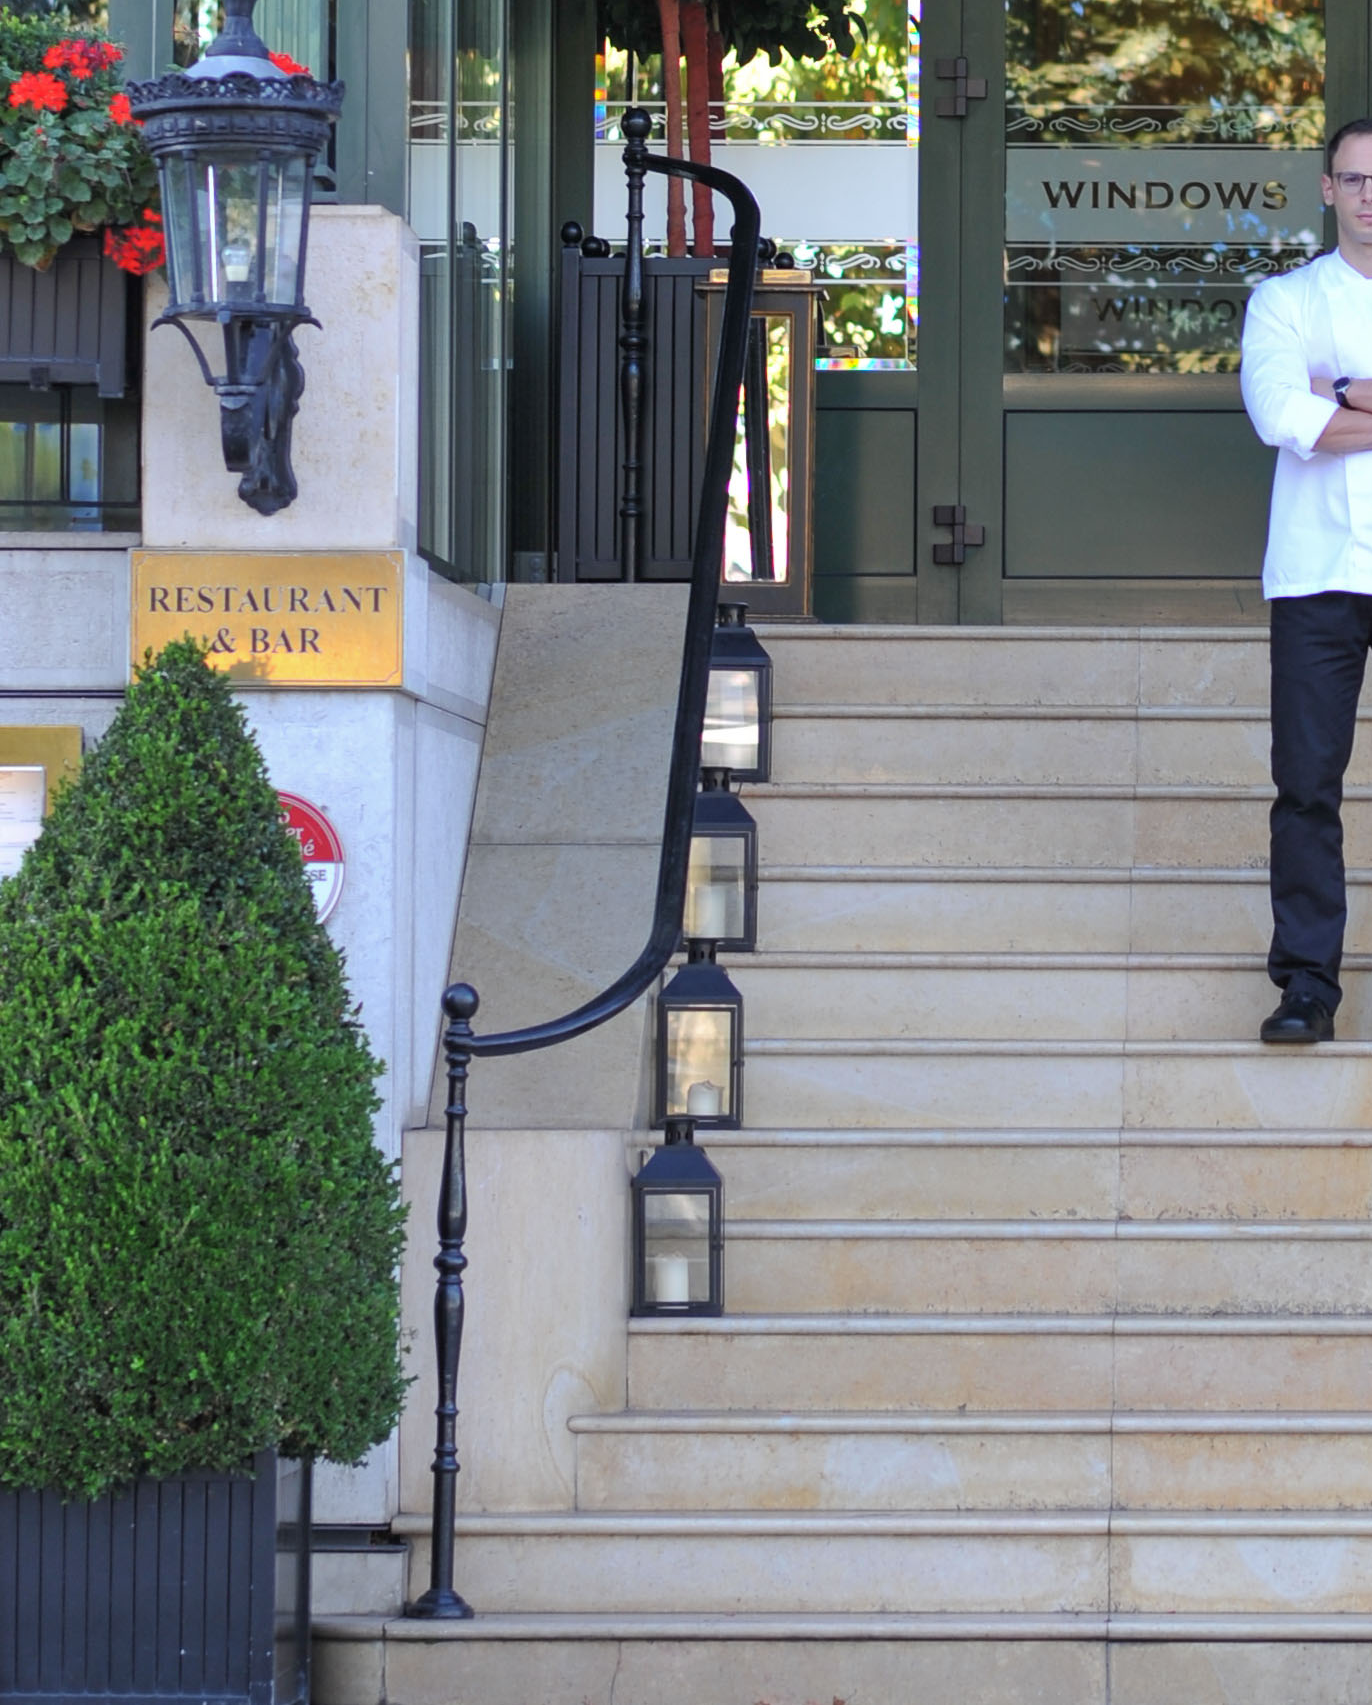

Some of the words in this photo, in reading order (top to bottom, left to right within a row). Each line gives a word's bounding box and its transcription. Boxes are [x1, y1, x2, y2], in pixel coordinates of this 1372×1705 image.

[1041, 180, 1289, 211] WINDOWS
[1092, 297, 1246, 323] WINDO
[149, 586, 388, 613] RESTAURANT
[210, 627, 237, 655] &
[250, 627, 323, 655] BAR
